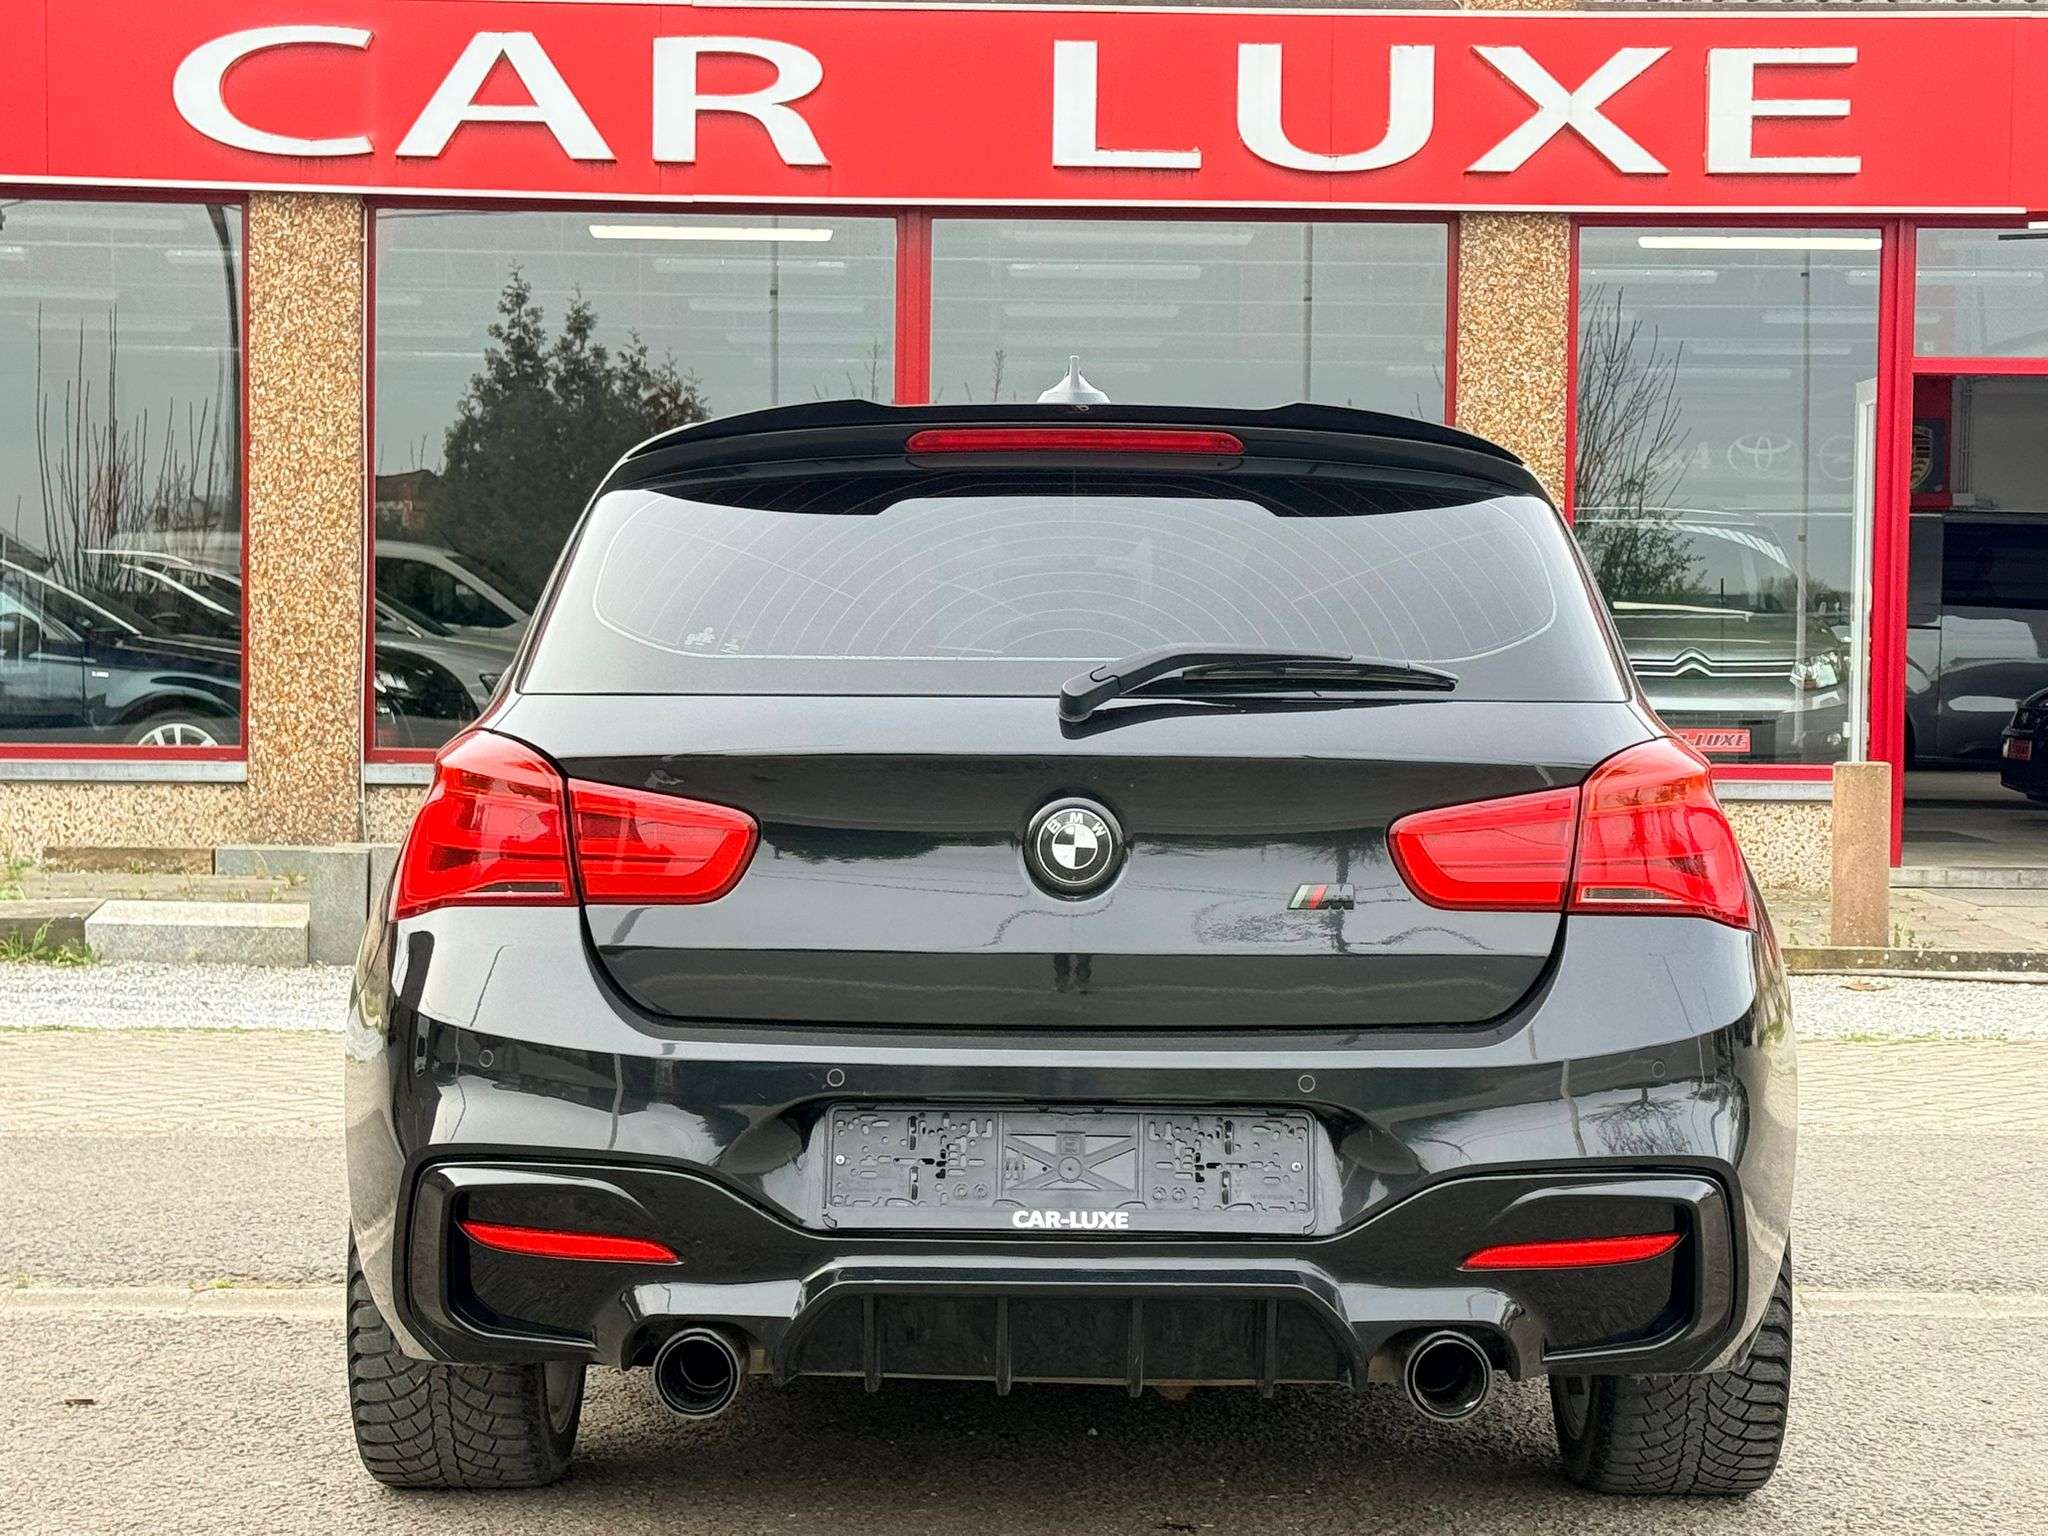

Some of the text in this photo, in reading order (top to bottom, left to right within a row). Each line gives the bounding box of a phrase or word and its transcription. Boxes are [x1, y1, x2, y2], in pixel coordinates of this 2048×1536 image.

[172, 25, 1862, 175] CAR LUXE
[1046, 812, 1107, 838] BMW
[1012, 1210, 1129, 1229] CAR-LUXE
